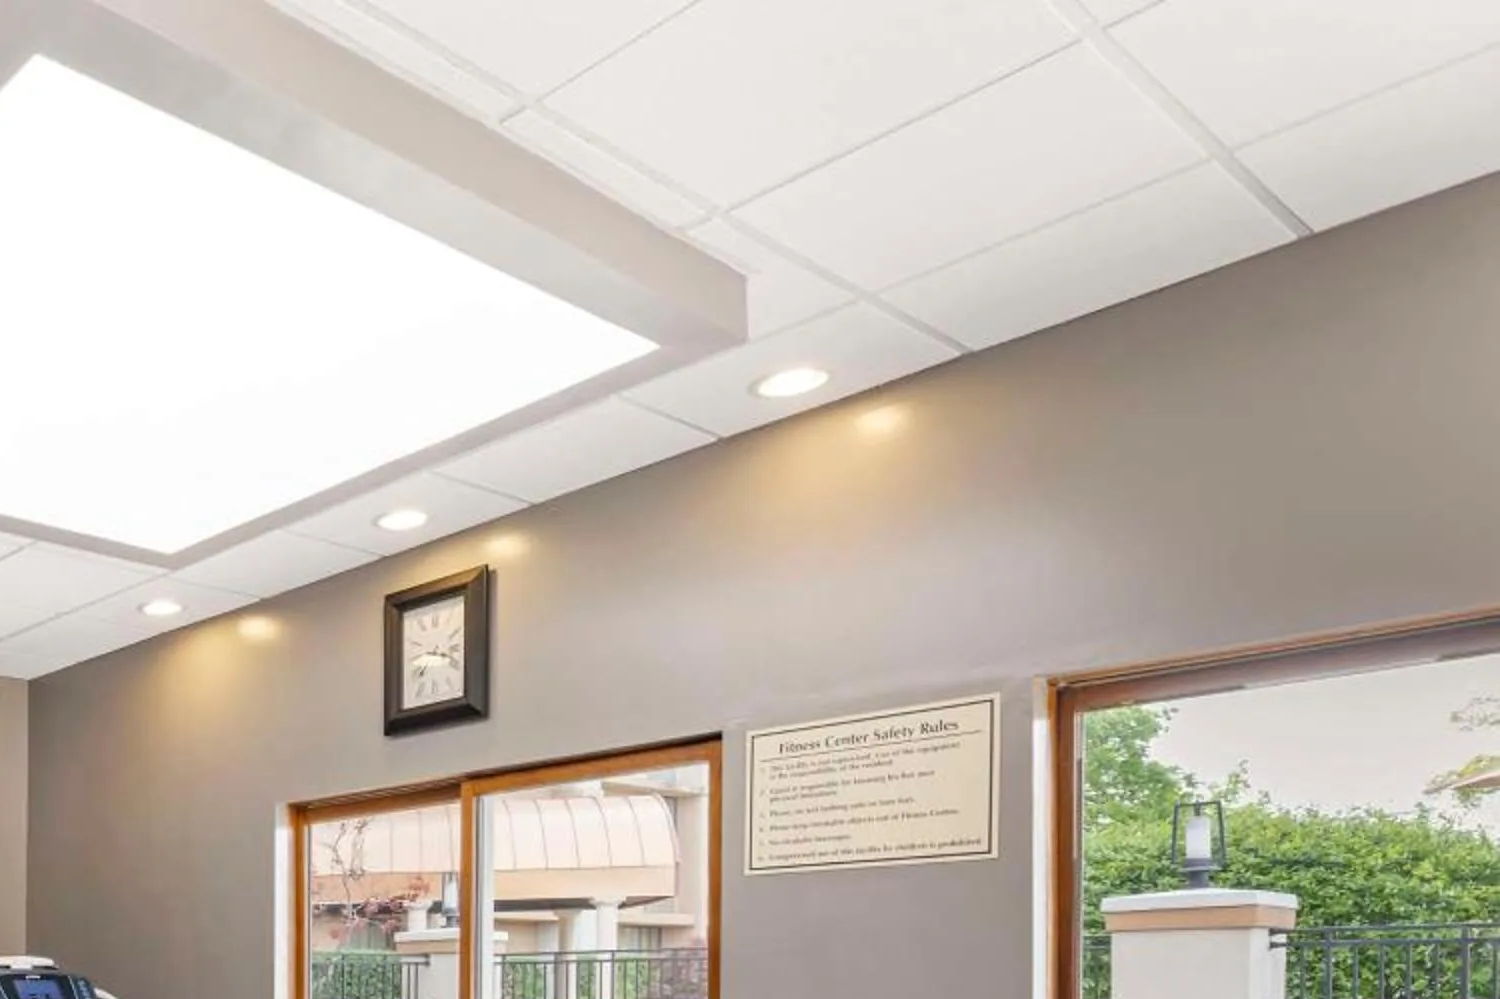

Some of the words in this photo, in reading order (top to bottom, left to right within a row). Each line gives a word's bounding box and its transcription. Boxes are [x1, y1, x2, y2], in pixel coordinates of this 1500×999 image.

[778, 740, 821, 755] Fitness
[825, 732, 868, 749] Center
[873, 725, 914, 742] Safety
[919, 719, 959, 735] Rules
